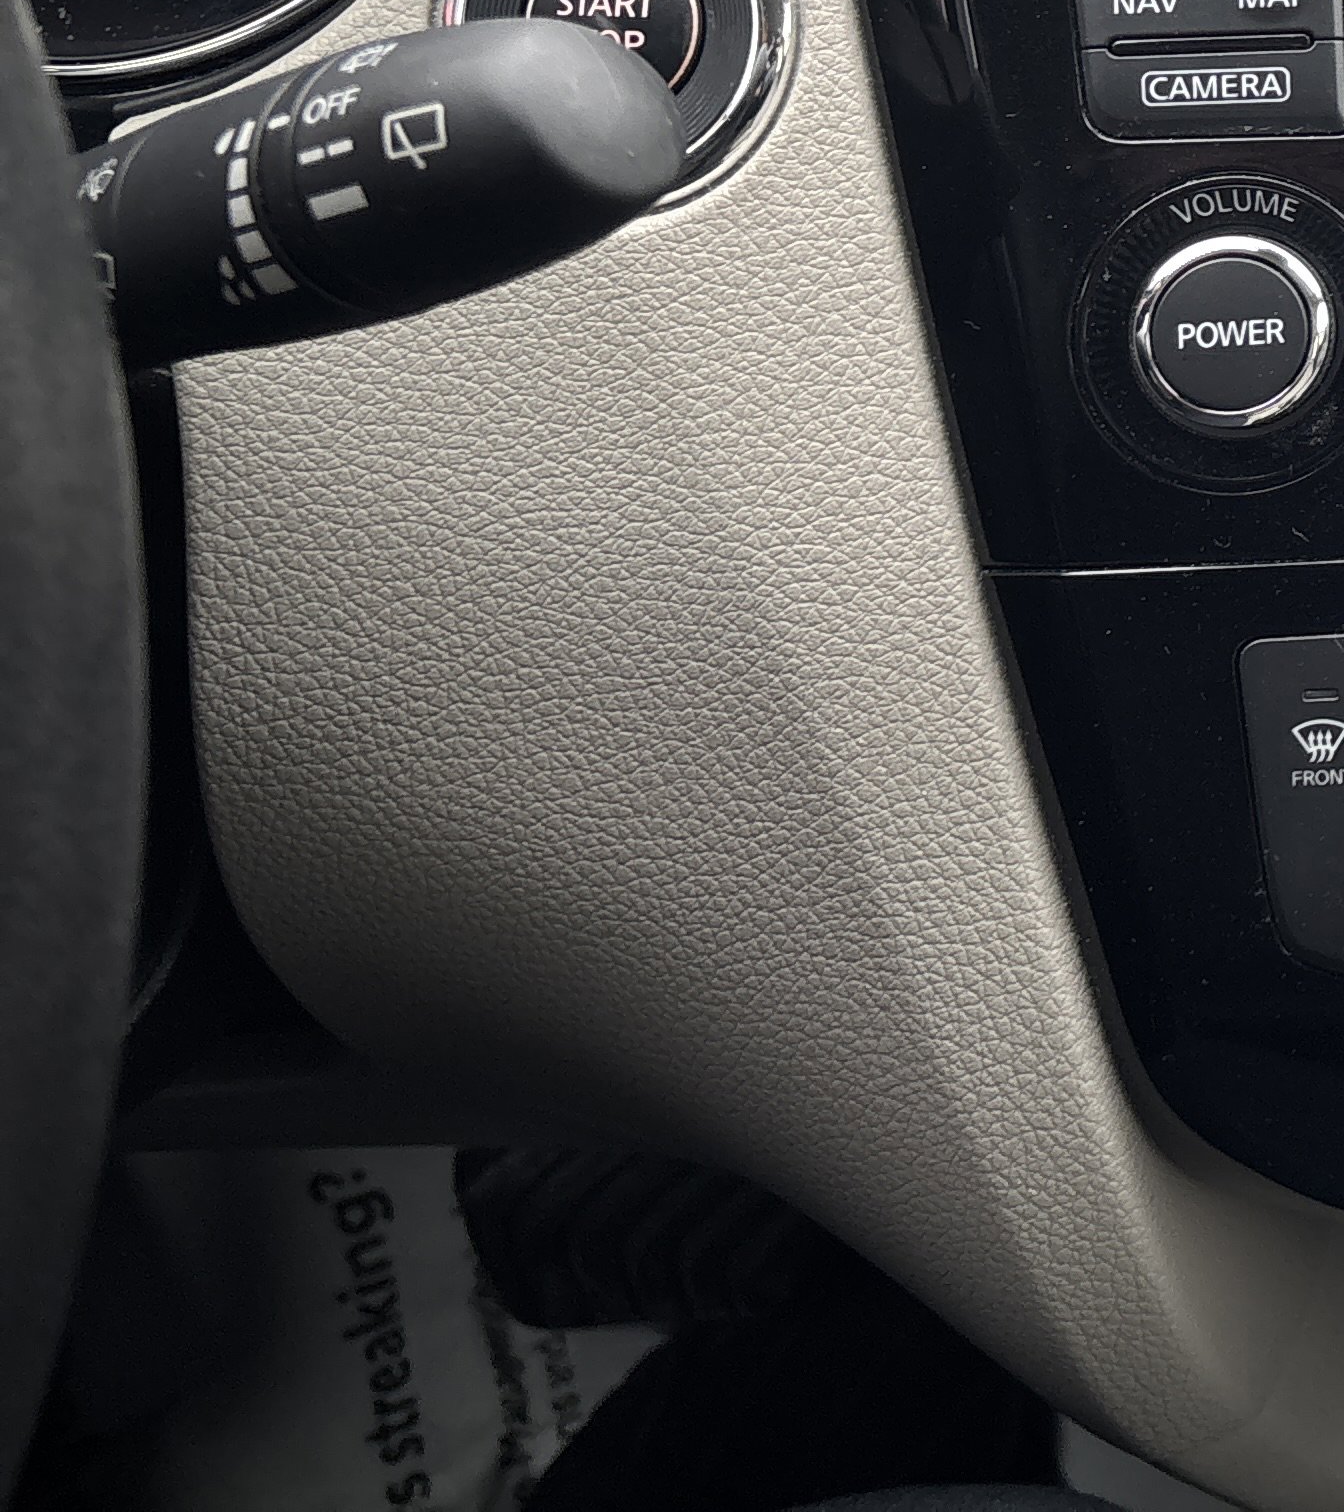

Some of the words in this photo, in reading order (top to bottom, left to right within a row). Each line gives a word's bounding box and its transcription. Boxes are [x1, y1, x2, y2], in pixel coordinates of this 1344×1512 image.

[302, 84, 361, 124] OFF
[1149, 73, 1283, 101] CAMERA
[1169, 188, 1300, 223] VOLUME
[1177, 318, 1286, 349] POWER
[306, 1166, 425, 1467] streaking?
